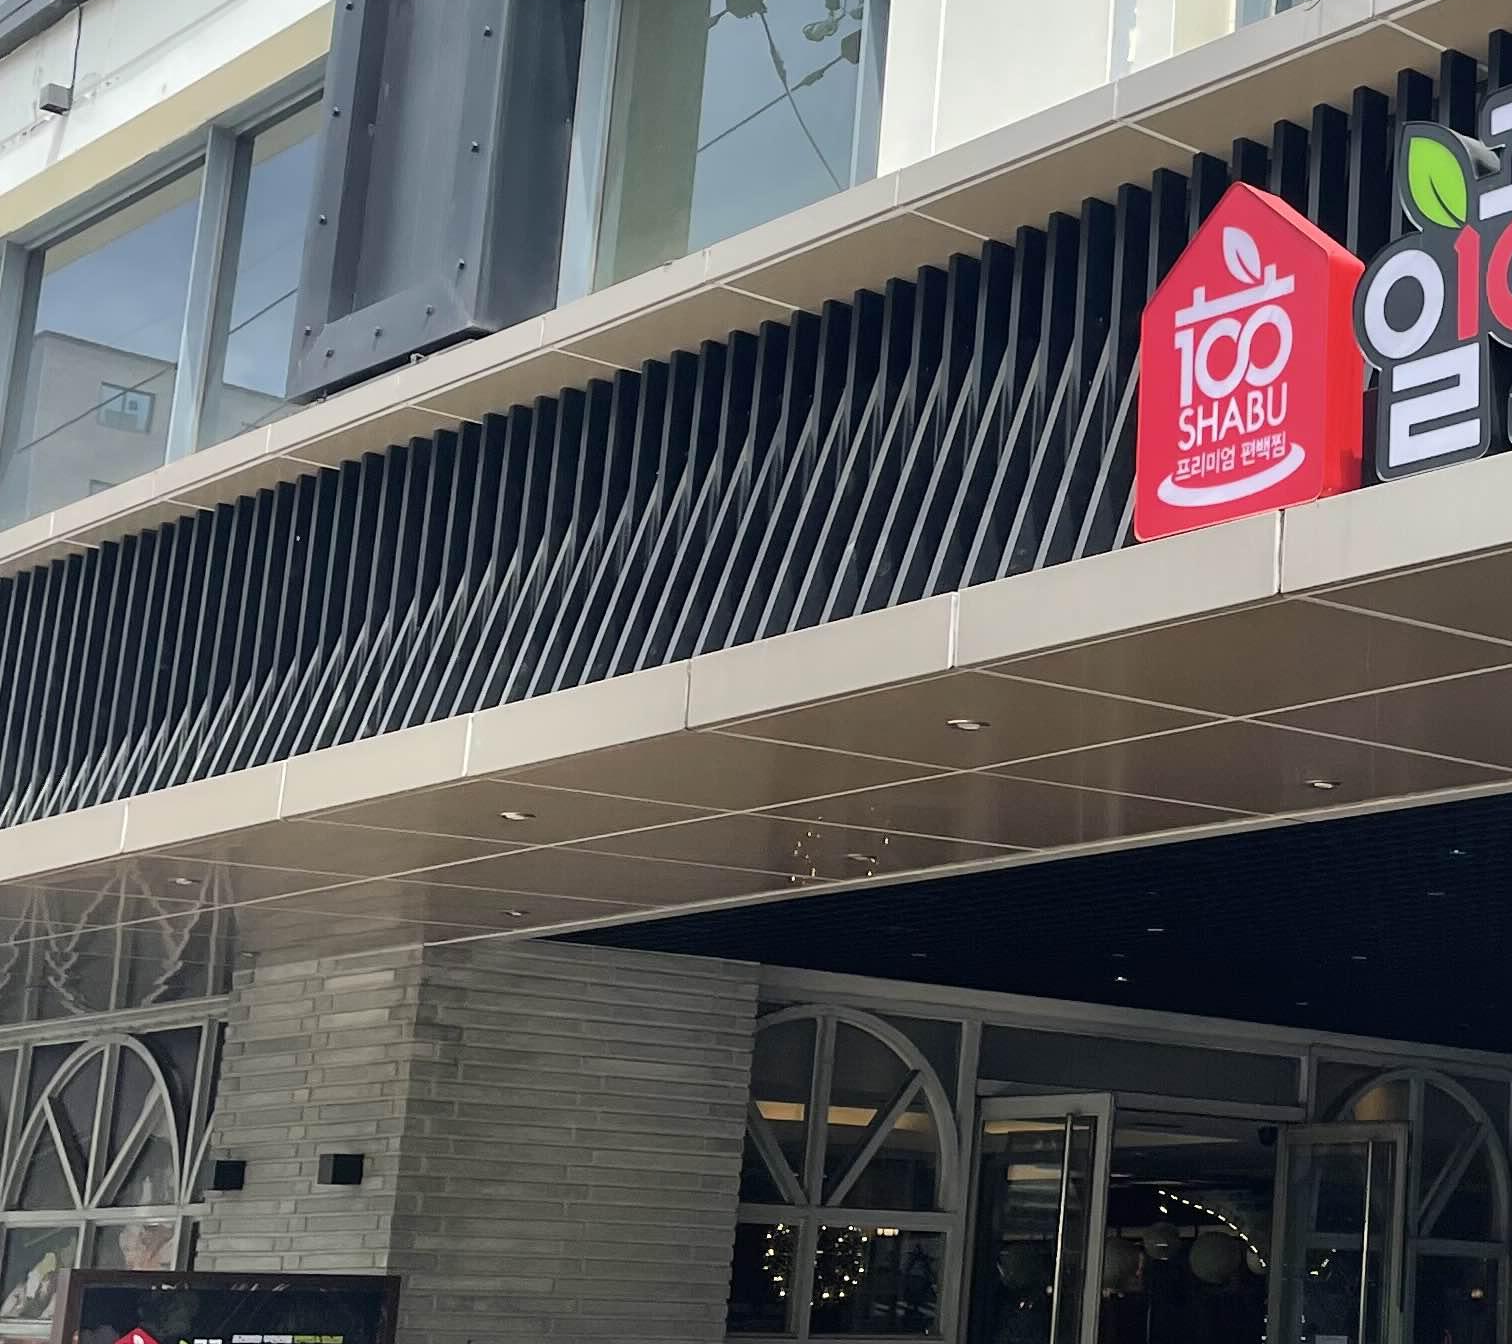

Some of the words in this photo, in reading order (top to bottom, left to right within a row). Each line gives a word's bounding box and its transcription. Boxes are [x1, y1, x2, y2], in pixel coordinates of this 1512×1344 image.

[1174, 303, 1294, 408] 100
[1177, 381, 1289, 452] SHABU
[1175, 443, 1236, 482] 프리미엄
[1240, 430, 1287, 467] 편백찜
